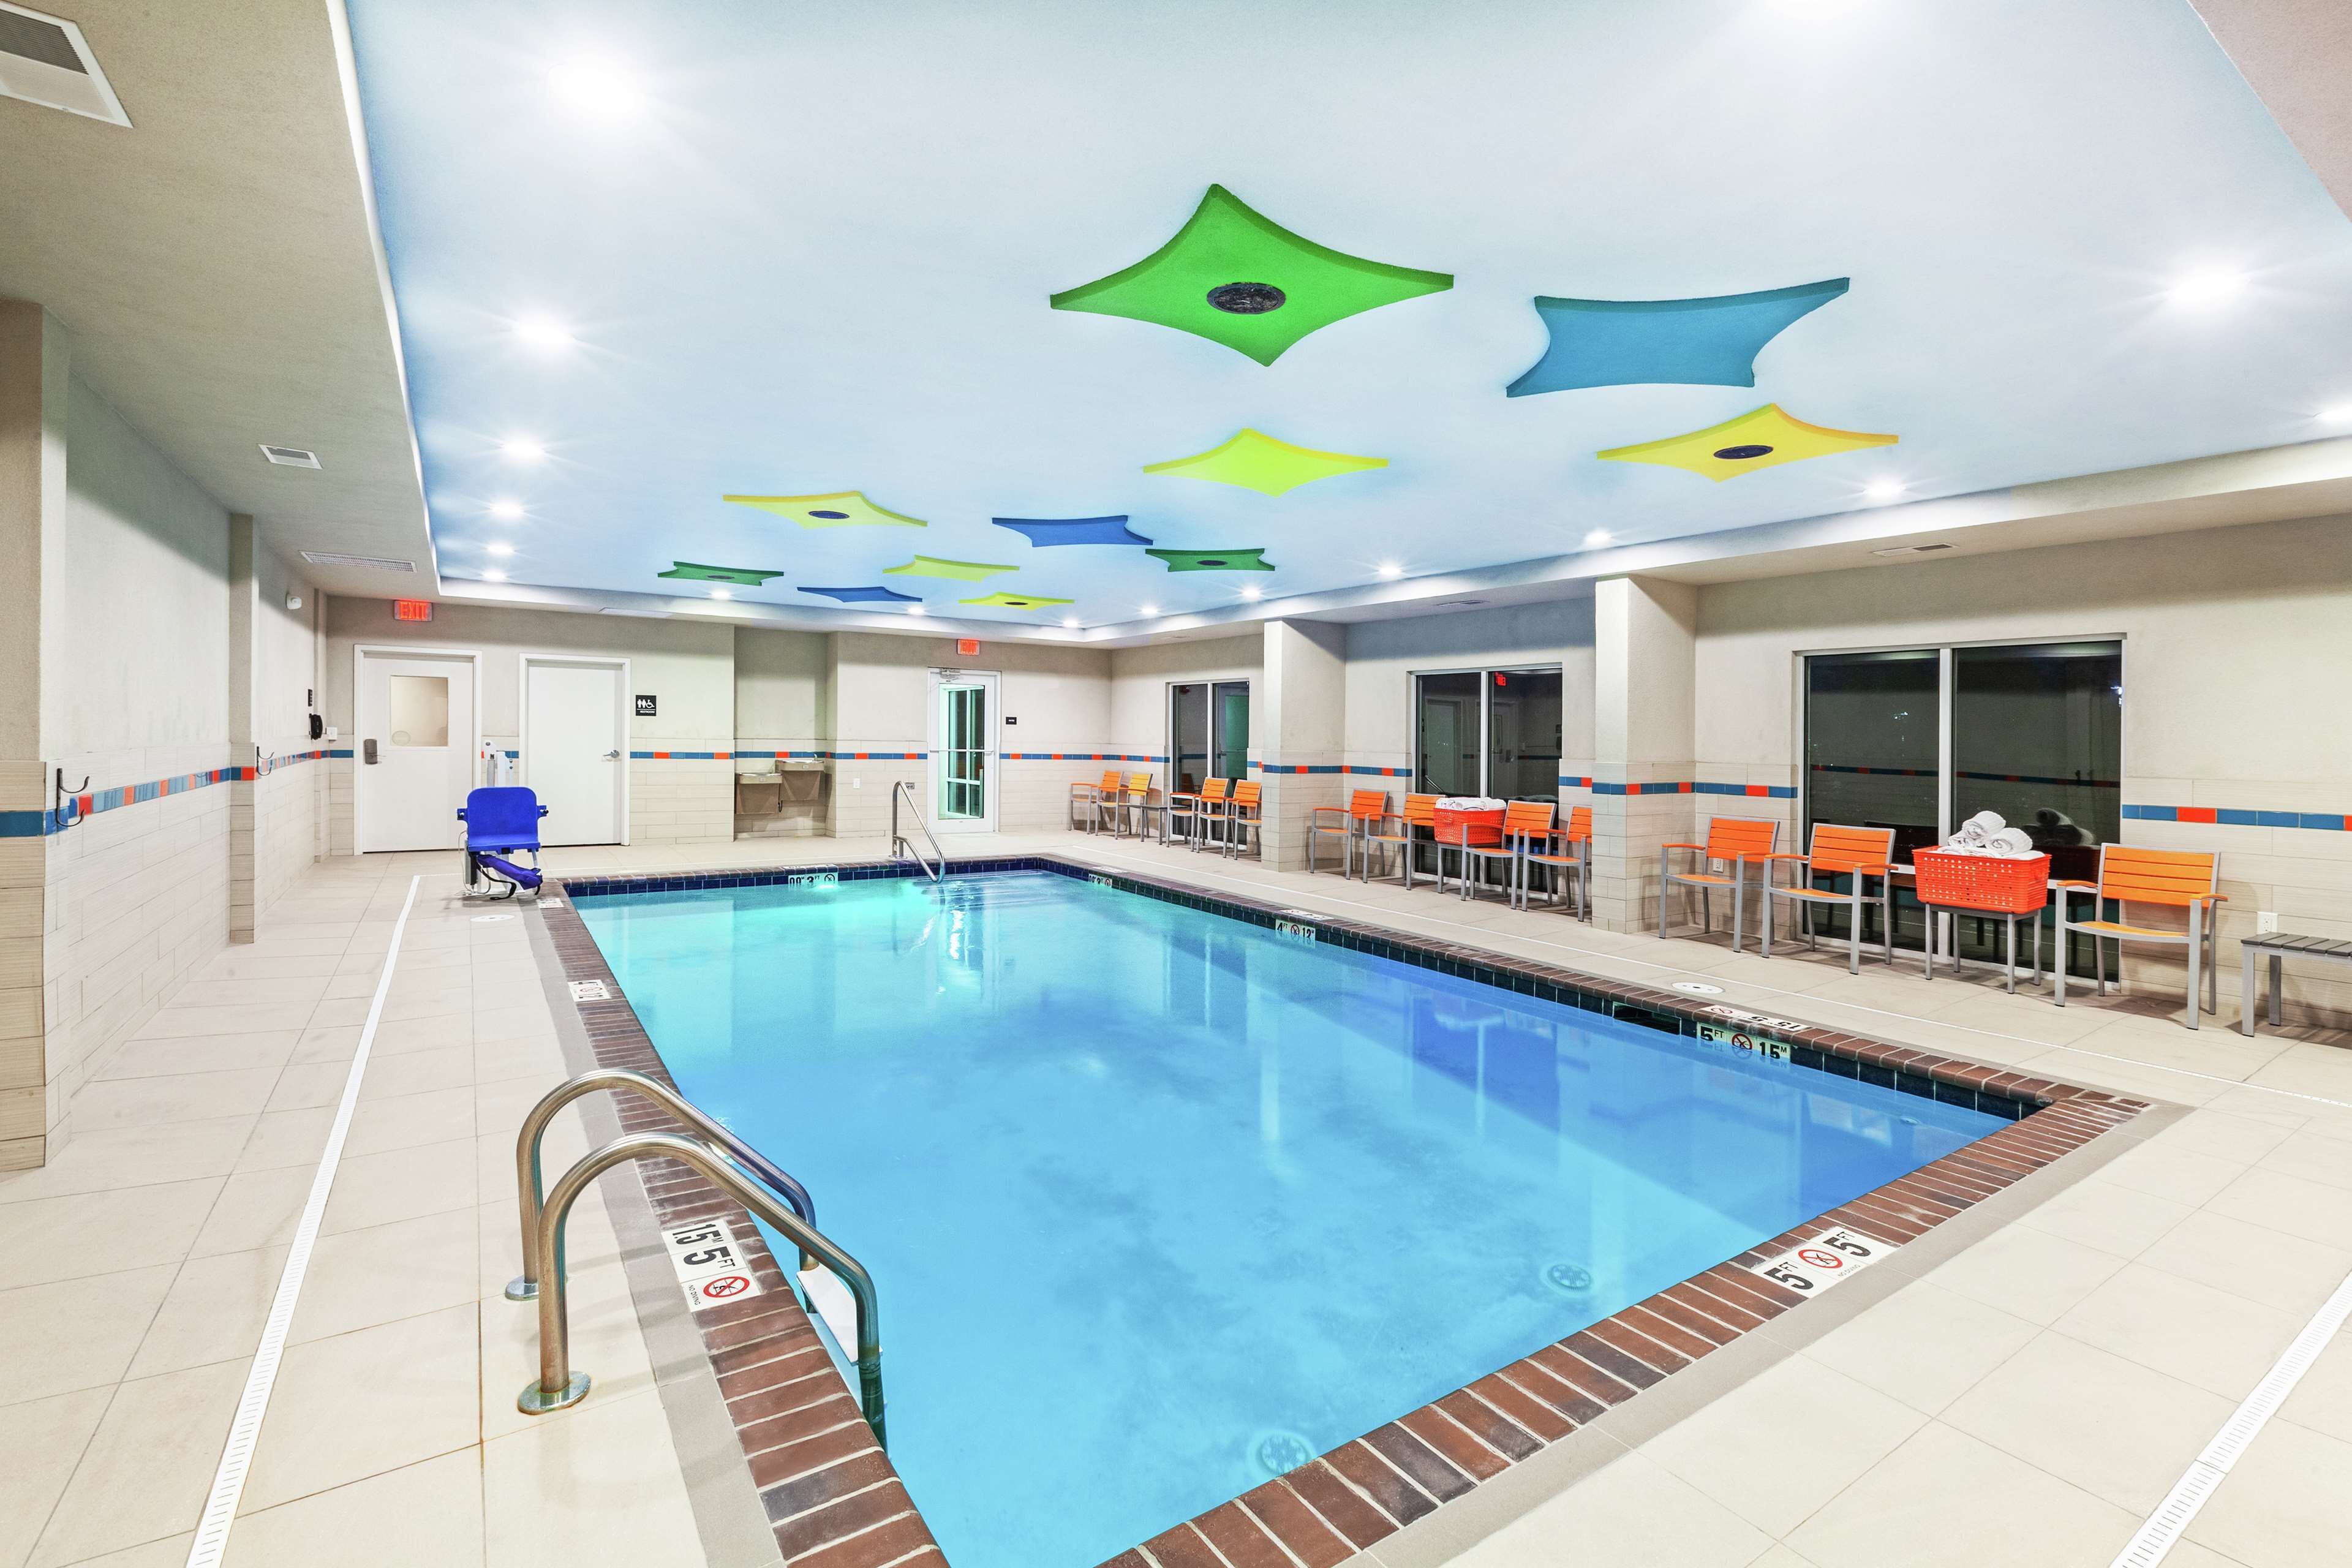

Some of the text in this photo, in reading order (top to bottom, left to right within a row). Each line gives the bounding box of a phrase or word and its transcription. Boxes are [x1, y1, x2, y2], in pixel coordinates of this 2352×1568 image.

[400, 602, 427, 619] EXIT
[1715, 1030, 1724, 1039] FT
[1823, 1231, 1871, 1256] 5 FT
[684, 1246, 736, 1268] 5 FT
[1764, 1262, 1814, 1290] 5 FT
